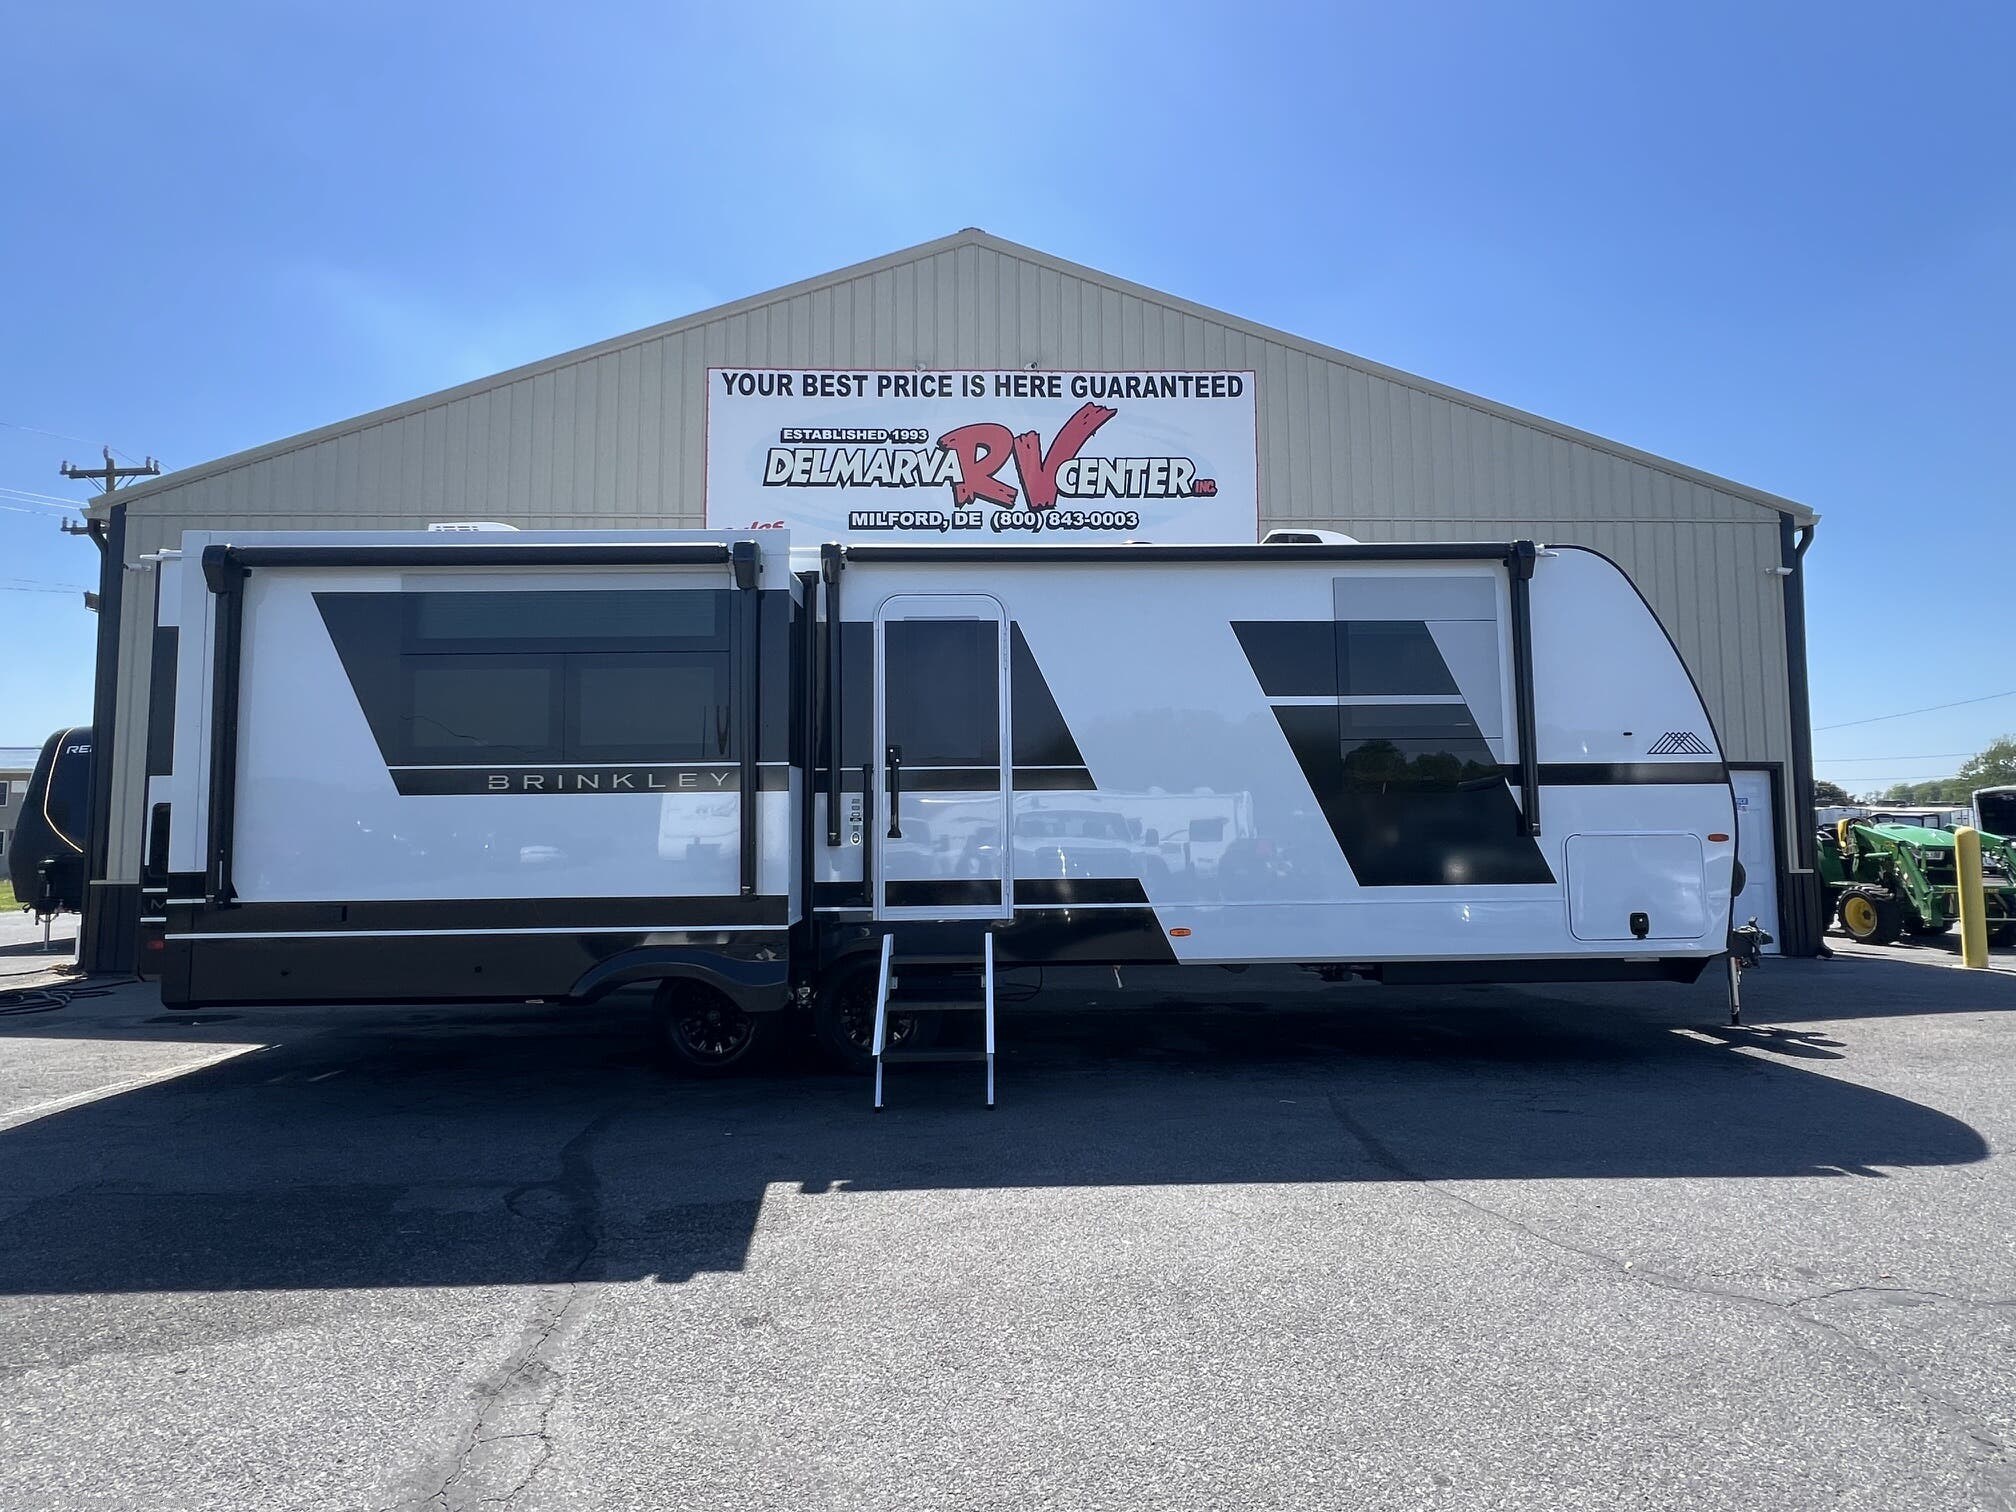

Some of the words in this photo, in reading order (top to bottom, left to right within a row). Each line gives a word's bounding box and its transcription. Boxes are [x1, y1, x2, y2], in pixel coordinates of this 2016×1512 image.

[721, 373, 793, 397] YOUR
[802, 374, 868, 397] BEST
[877, 375, 952, 398] PRICE
[962, 375, 986, 398] IS
[994, 375, 1063, 398] HERE
[1070, 375, 1243, 398] GUARANTEED
[781, 428, 889, 442] ESTABLISHED
[891, 429, 929, 443] 1993
[764, 448, 964, 487] DELMARVA
[937, 402, 1118, 511] RV
[1055, 457, 1196, 498] CENTER
[850, 511, 949, 532] MILFORD,
[953, 511, 983, 529] DE
[992, 511, 1045, 532] (800)
[1047, 511, 1140, 530] 843-0003
[66, 744, 92, 755] RE
[488, 772, 730, 790] BRINKLEY
